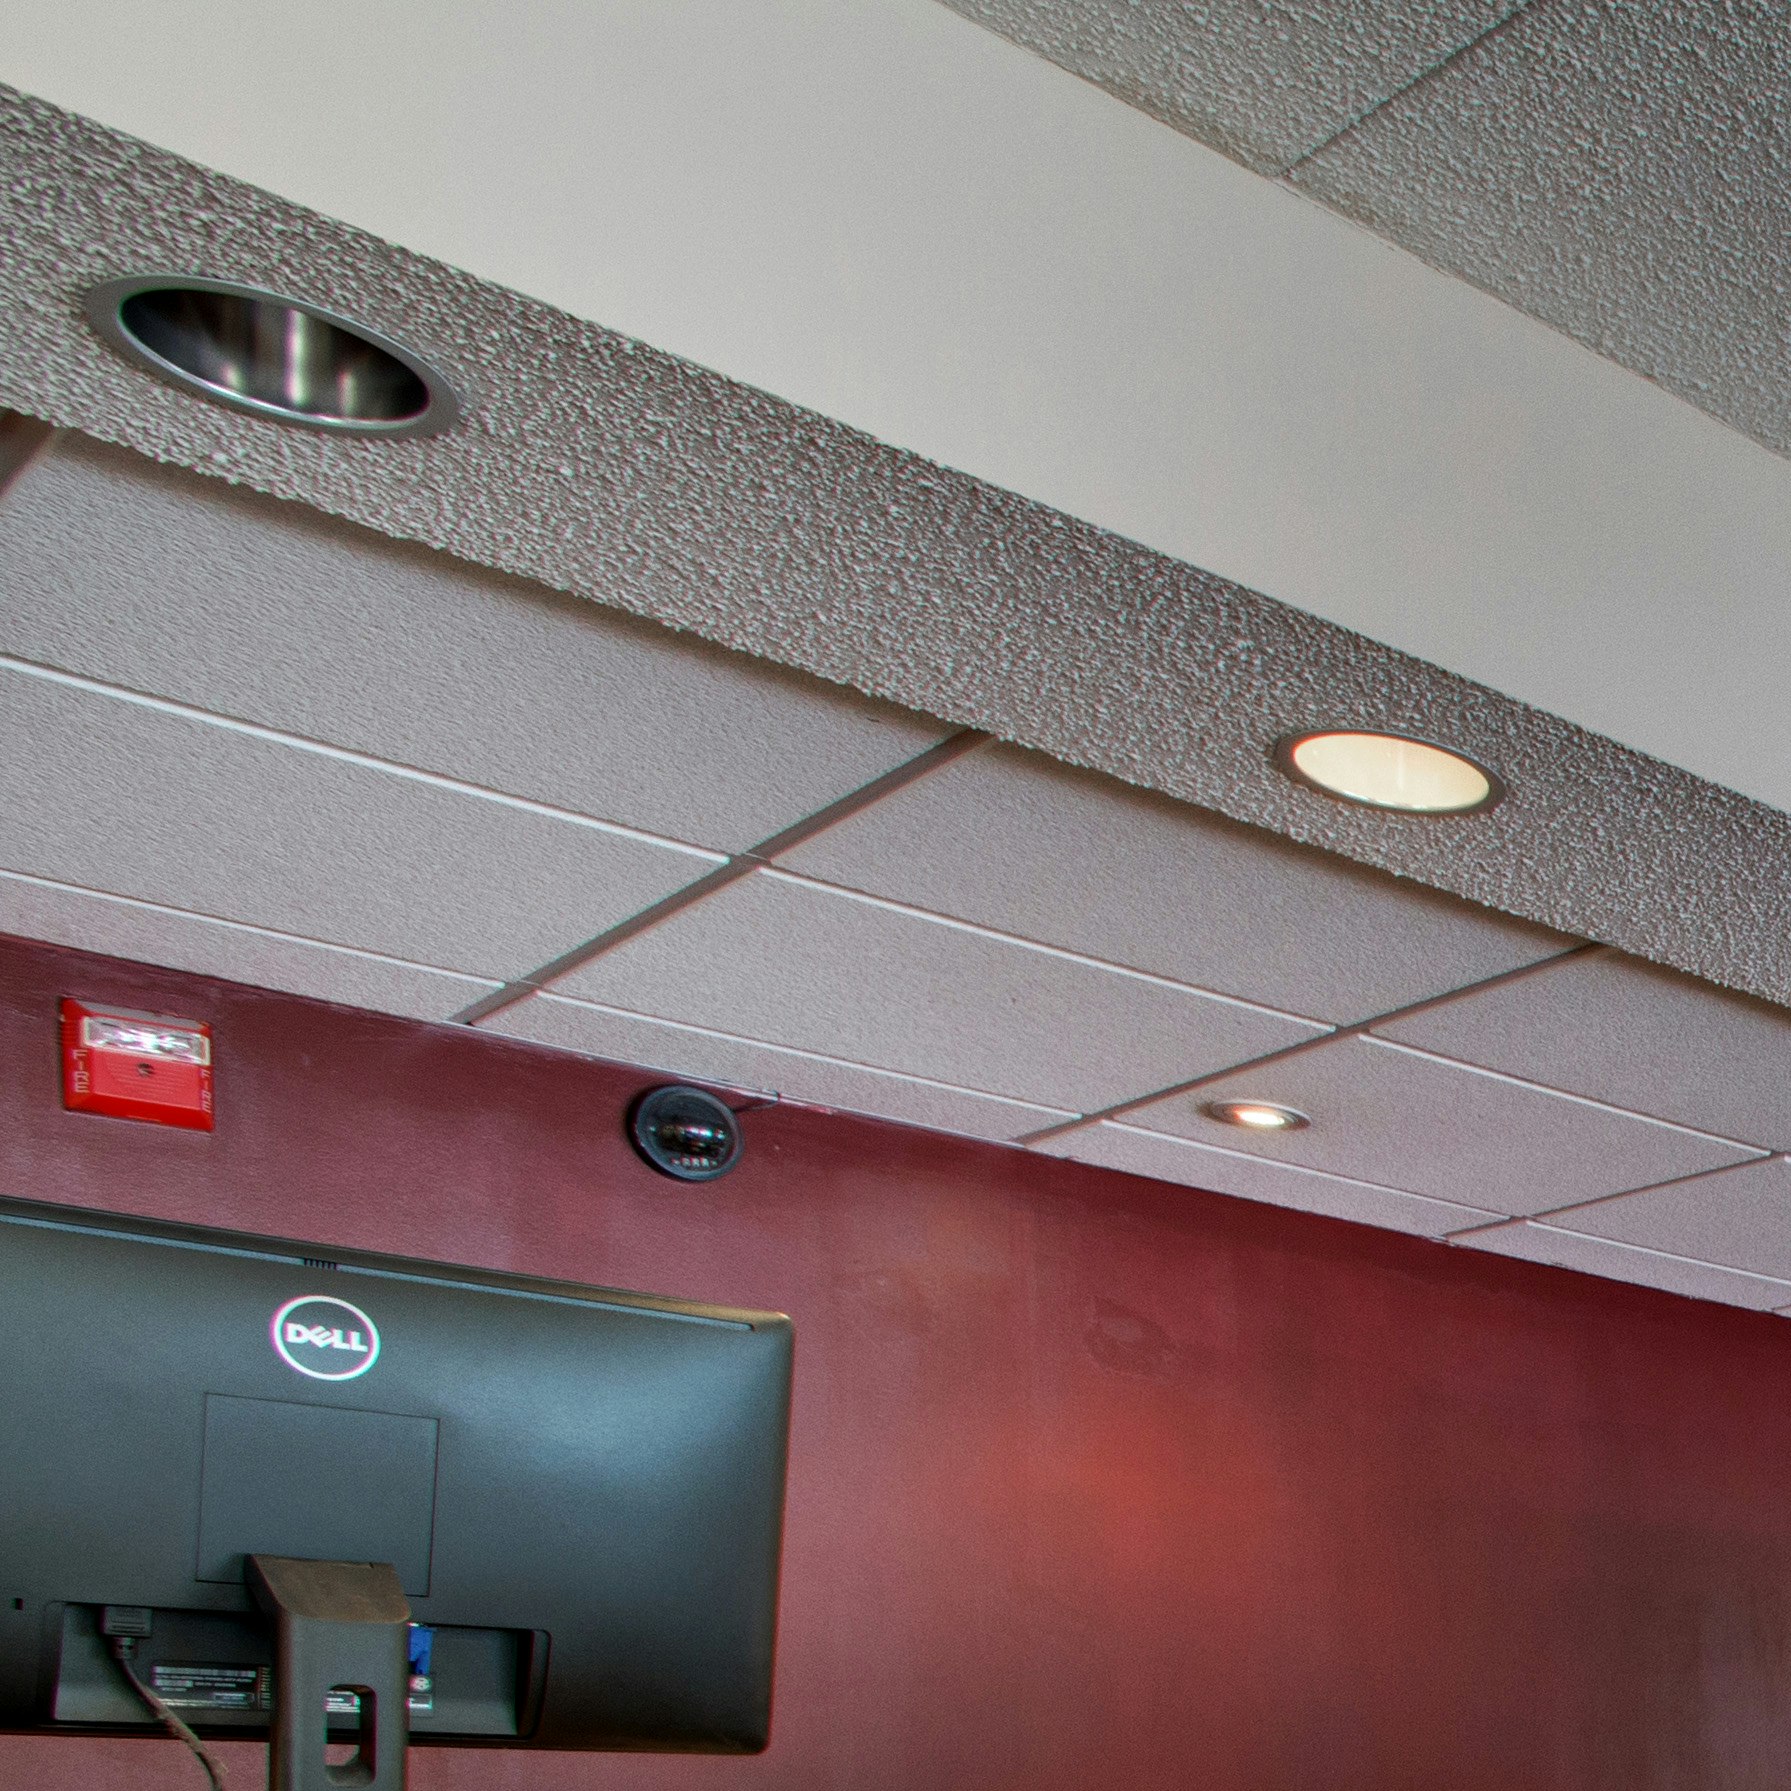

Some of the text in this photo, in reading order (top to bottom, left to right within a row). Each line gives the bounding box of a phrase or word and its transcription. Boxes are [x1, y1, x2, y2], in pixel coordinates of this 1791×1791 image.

[73, 1049, 90, 1094] FIRE
[200, 1069, 212, 1114] FIRE
[283, 1321, 369, 1353] DELL
